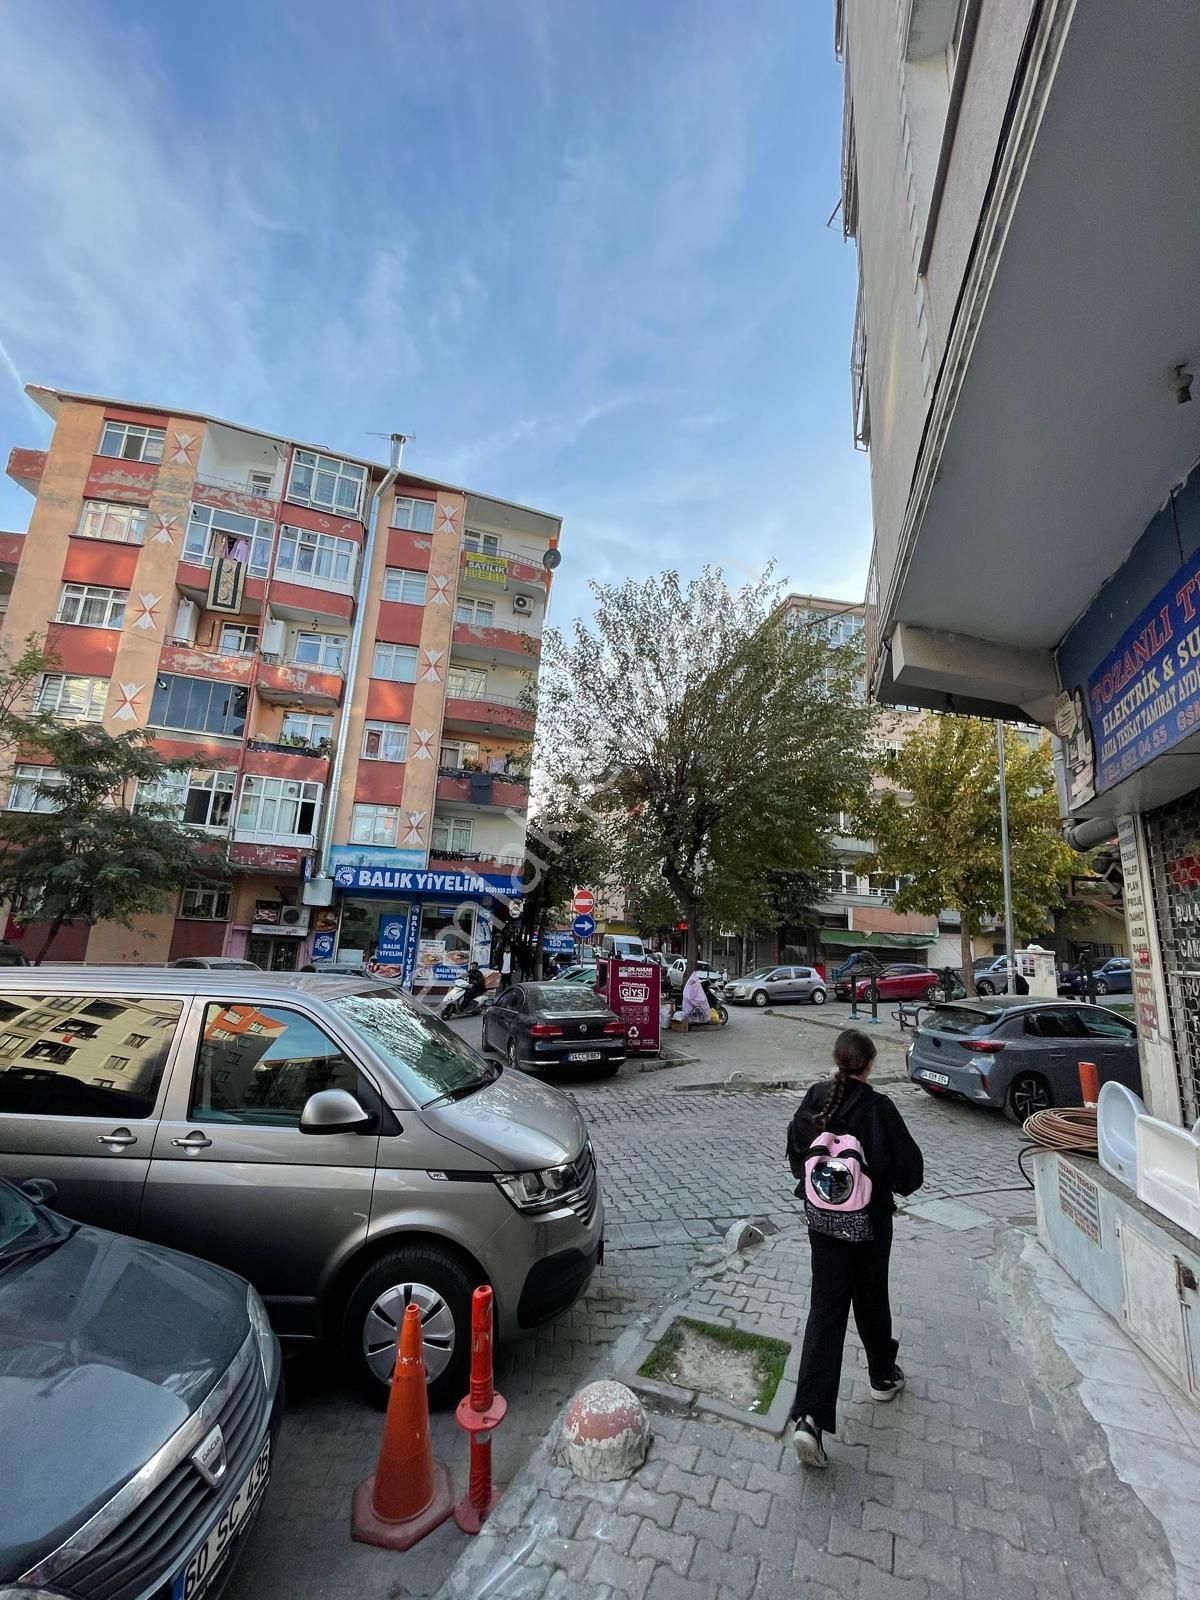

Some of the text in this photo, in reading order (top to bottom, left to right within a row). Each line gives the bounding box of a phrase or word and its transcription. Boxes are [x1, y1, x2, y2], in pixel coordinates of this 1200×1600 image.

[1090, 604, 1174, 715] TOZANLI
[1103, 666, 1160, 737] ELEKTRİK
[1162, 654, 1175, 681] &
[358, 870, 413, 888] BALIK
[409, 915, 418, 943] BALIK
[202, 1435, 222, 1462] DACIA
[184, 1540, 209, 1599] 60
[216, 1494, 241, 1552] SC
[246, 1443, 270, 1503] 436
